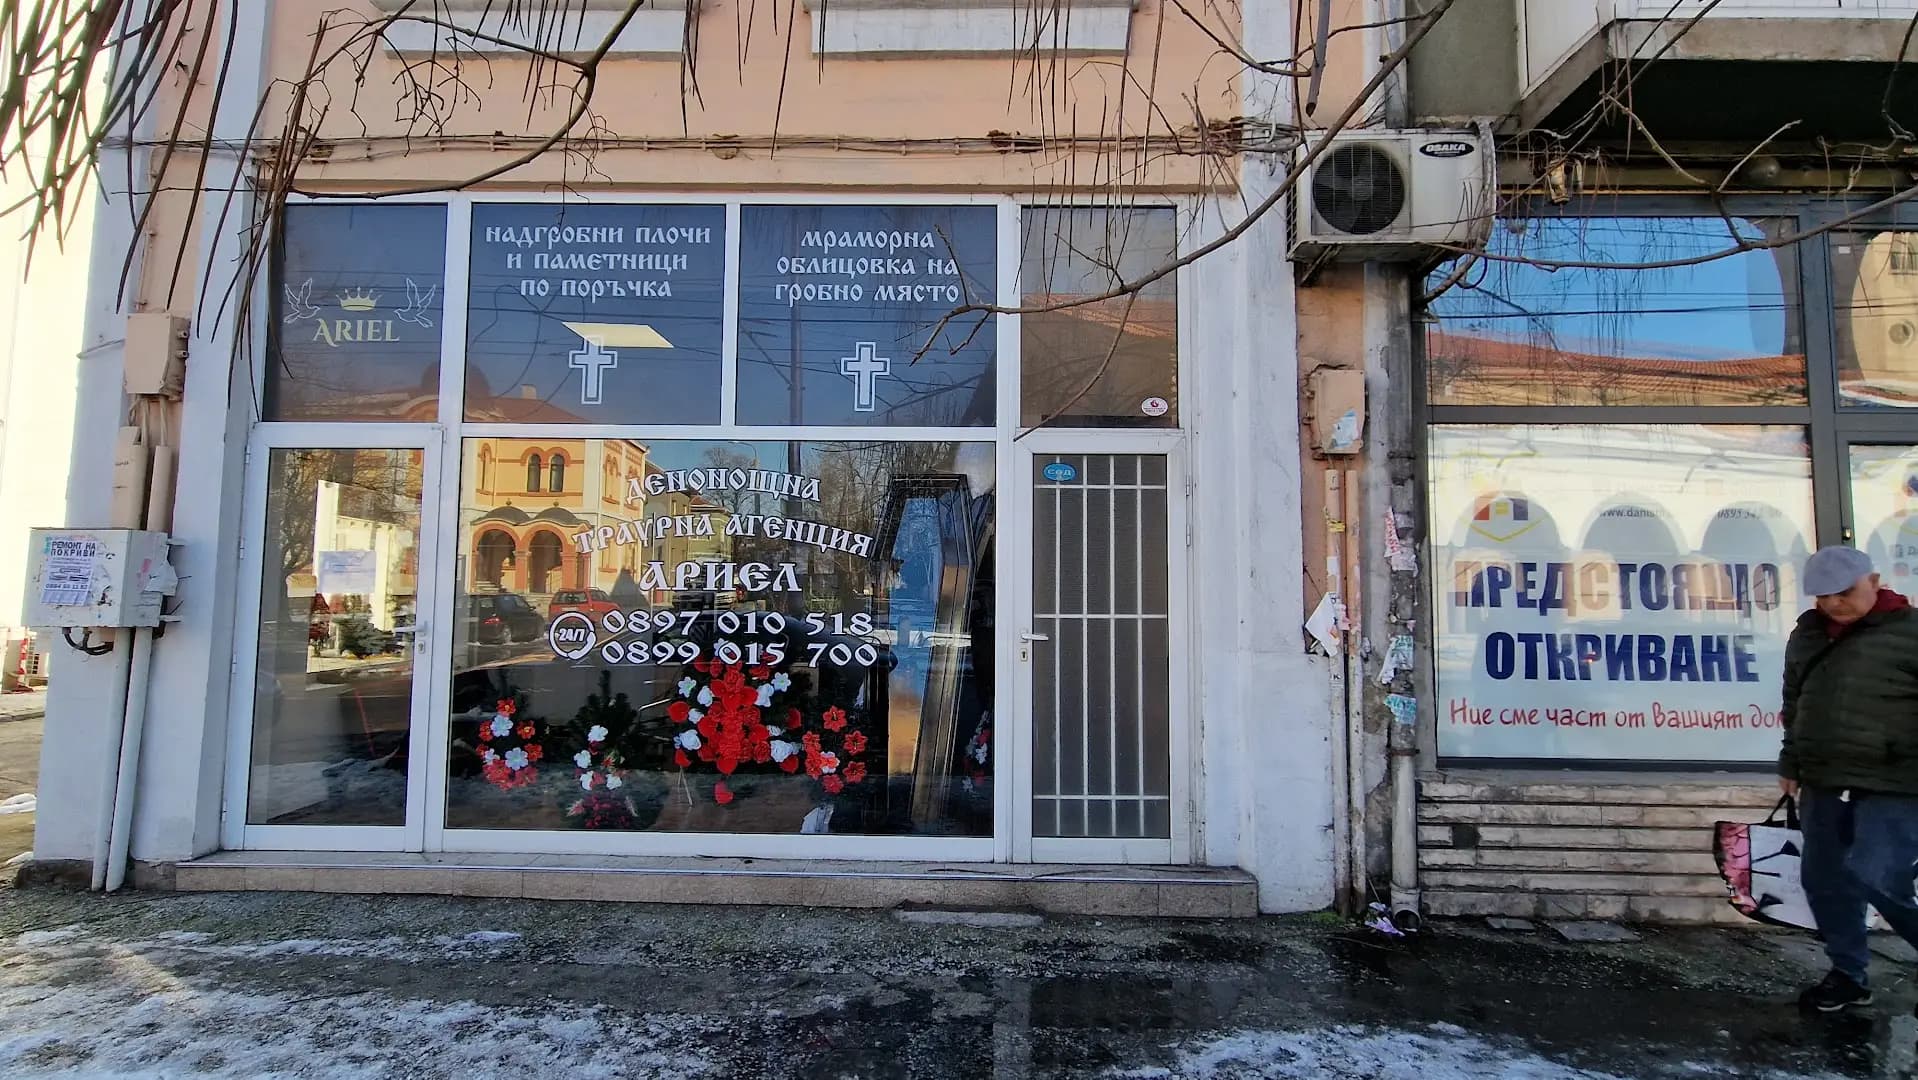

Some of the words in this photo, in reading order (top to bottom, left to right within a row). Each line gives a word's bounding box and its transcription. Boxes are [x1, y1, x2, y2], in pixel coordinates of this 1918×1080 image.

[1426, 144, 1466, 152] OSAKA
[635, 226, 711, 244] ПЛОЧИ
[801, 230, 935, 255] МРАМОРНА
[506, 253, 522, 270] И
[534, 253, 688, 276] ПАМЕТНИЦИ
[776, 256, 916, 279] ОБЛИЦОВКА
[520, 278, 550, 297] ПО
[561, 279, 672, 303] ПОРЪЧКА
[775, 283, 863, 307] ГРОБНО
[874, 284, 959, 302] МЯСТО
[312, 318, 400, 347] ARIEL
[626, 467, 821, 505] ДЕНОНОЩНА
[51, 541, 82, 550] РЕМОНТ
[86, 542, 96, 550] НА
[572, 514, 715, 554] ТРАУРНА
[725, 514, 874, 558] АГЕНЦИЯ
[50, 549, 95, 557] ПОКРИВИ
[639, 560, 802, 593] АРИЕЛ
[1454, 560, 1781, 618] ПРЕДСТОЯЩО
[602, 609, 701, 635] 0897
[717, 610, 786, 635] 010
[805, 612, 874, 636] 518
[601, 639, 701, 665] 0899
[718, 641, 785, 666] 015
[806, 641, 878, 668] 700
[1485, 631, 1760, 682] ОТКРИВАНЕ
[1450, 697, 1494, 725] Ние
[1499, 708, 1540, 726] сме
[1546, 708, 1607, 727] част
[1615, 711, 1645, 728] от
